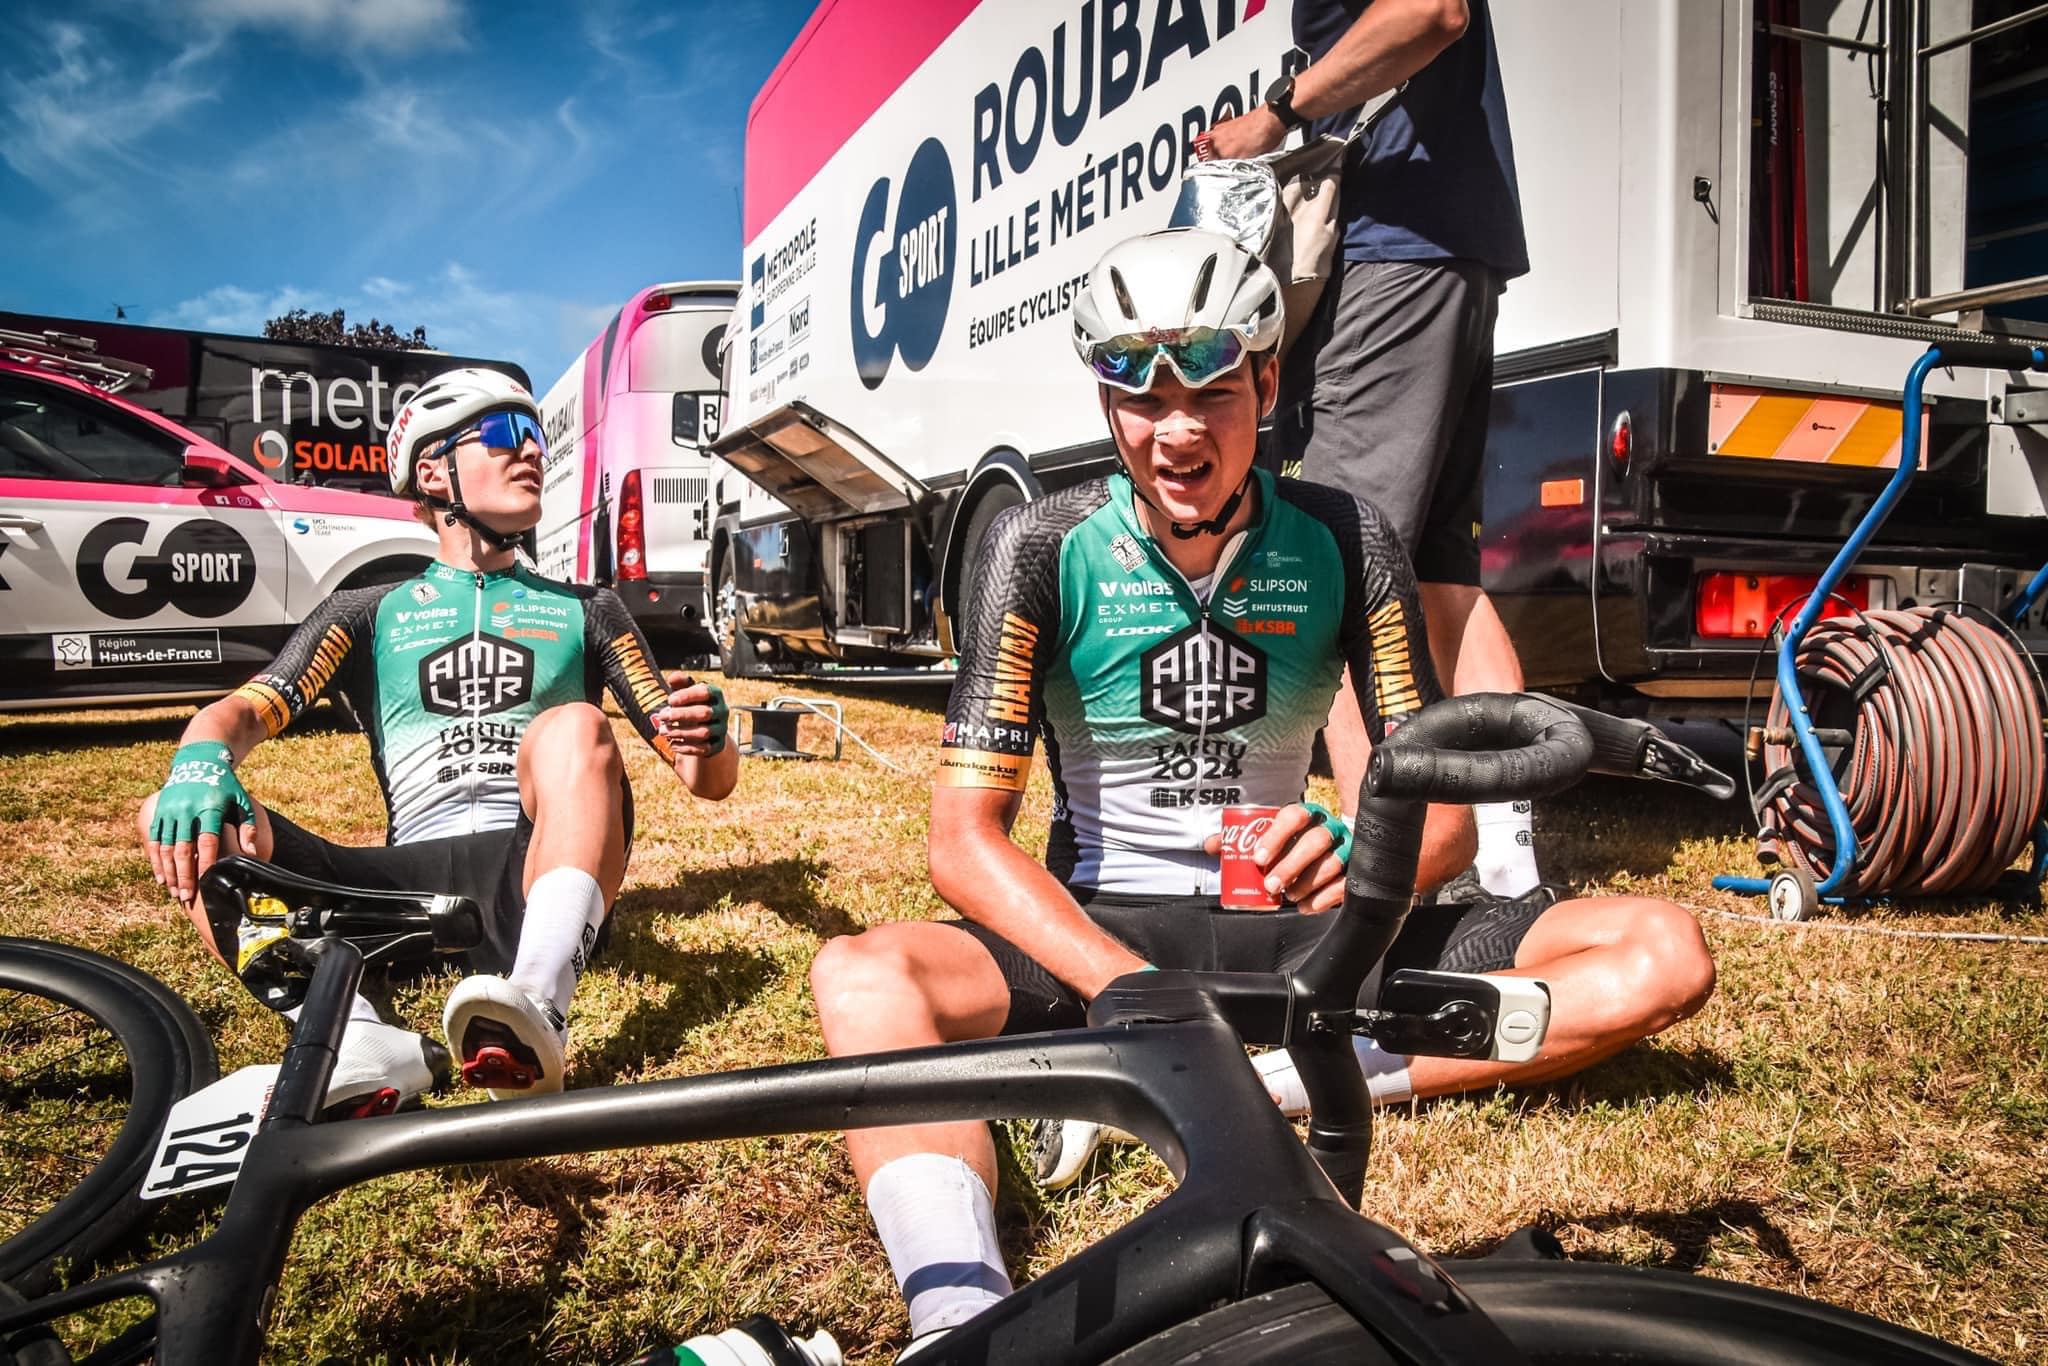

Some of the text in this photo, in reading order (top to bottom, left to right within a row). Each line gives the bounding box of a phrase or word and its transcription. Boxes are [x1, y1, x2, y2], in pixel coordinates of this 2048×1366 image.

[767, 218, 816, 286] MÉTROPOLE
[899, 205, 948, 299] SPORT
[970, 199, 1041, 288] LILLE
[790, 300, 809, 337] Nord
[969, 306, 1015, 349] ÉQUIPE
[389, 406, 414, 480] HOLM
[295, 440, 388, 473] SOLAR
[171, 553, 242, 583] SPORT
[1250, 579, 1308, 592] SLIPSON
[513, 604, 568, 617] SLIPSON
[1098, 602, 1178, 616] EXMET
[1251, 603, 1309, 613] EHITUSTRUST
[390, 619, 458, 638] EXMET
[1105, 625, 1177, 637] LOOK
[1255, 619, 1297, 635] KSBR
[98, 638, 137, 650] Région
[100, 648, 212, 663] Hauts-de-France
[297, 623, 353, 706] HAWAII
[957, 723, 1029, 744] MAPRI
[437, 738, 517, 761] 2024
[1151, 738, 1248, 761] TARTU
[164, 770, 220, 787] 2024
[171, 760, 227, 776] TARTU
[461, 761, 516, 777] KSBR
[1151, 757, 1243, 781] 2024
[1179, 787, 1242, 807] KSBR
[147, 1112, 254, 1192] 124
